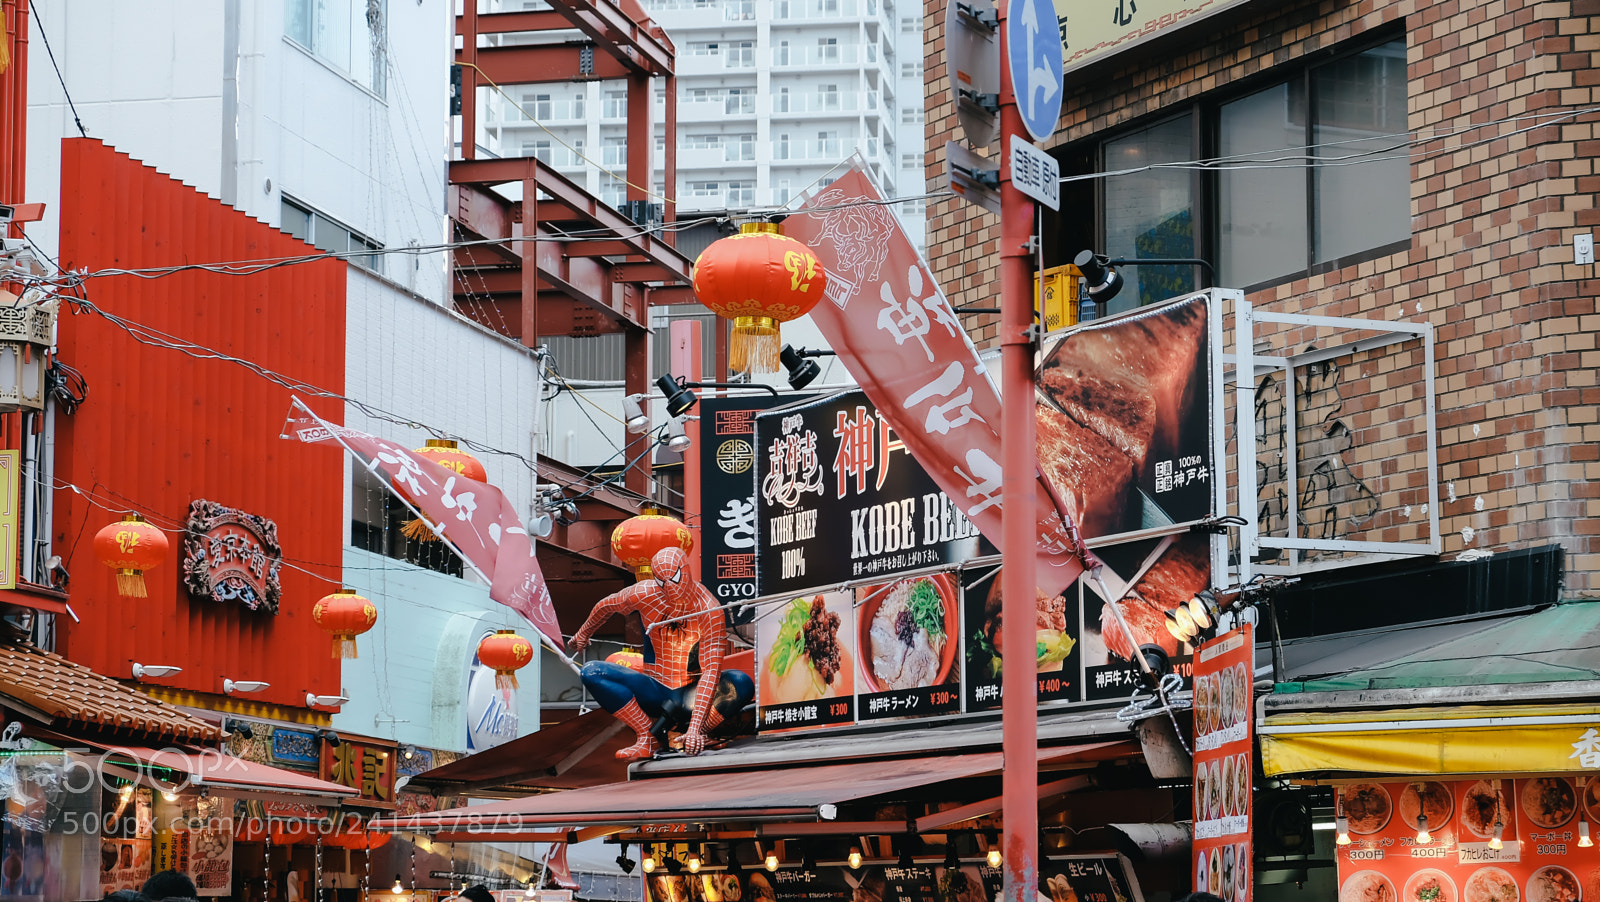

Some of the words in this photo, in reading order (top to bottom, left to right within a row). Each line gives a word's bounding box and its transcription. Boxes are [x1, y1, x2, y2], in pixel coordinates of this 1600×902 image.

[1173, 465, 1210, 488] 神戸牛
[769, 513, 794, 547] KOBE
[795, 508, 818, 541] BEEF
[850, 498, 916, 560] KOBE
[781, 547, 806, 580] 100%
[829, 702, 848, 717] ¥300
[1529, 831, 1573, 842] マーボー丼
[1350, 850, 1385, 860] 300円
[1411, 848, 1447, 858] 400円
[1536, 844, 1567, 855] 300円
[1068, 862, 1102, 877] 生ビール
